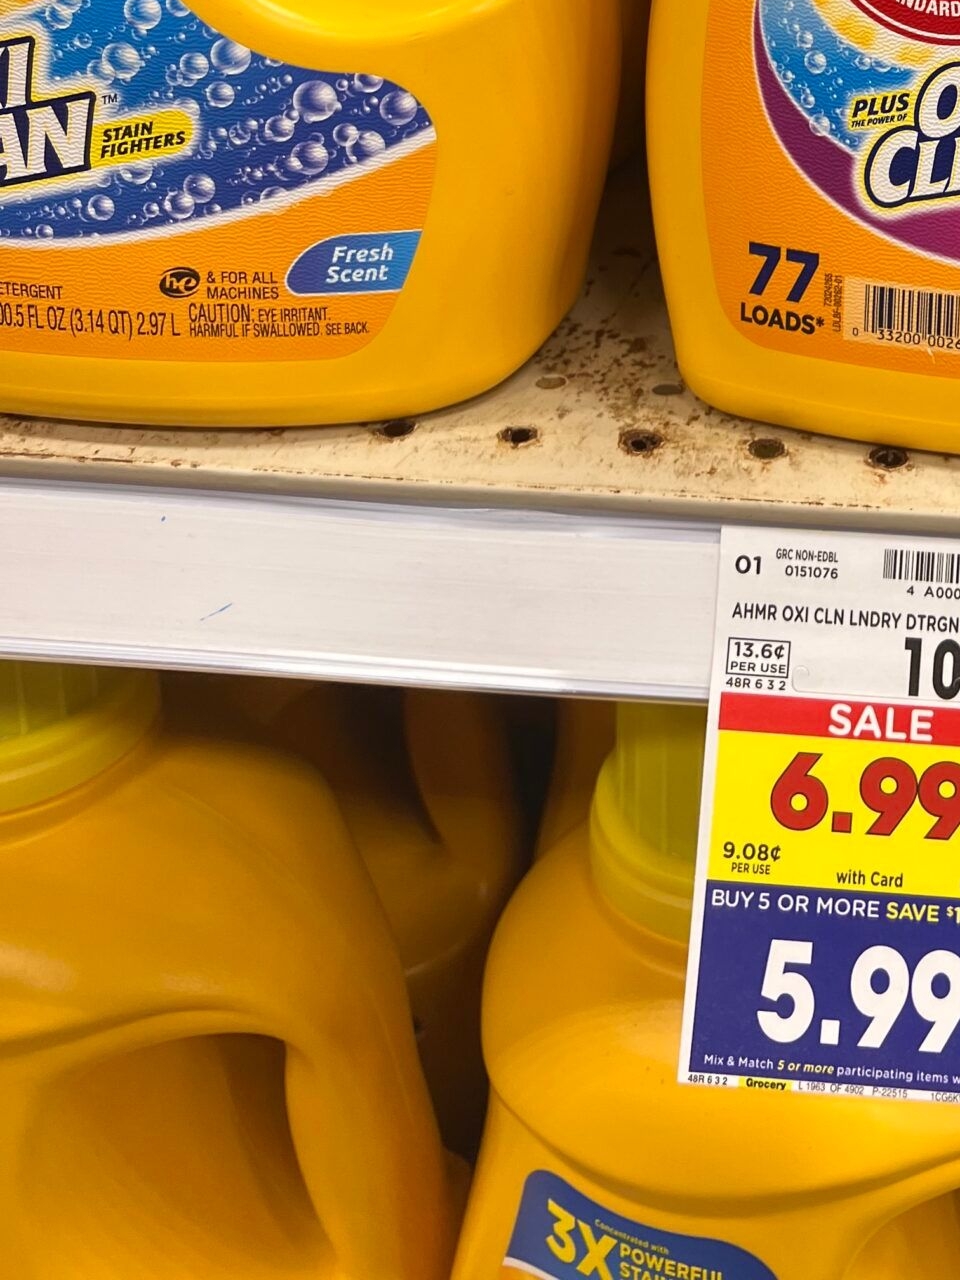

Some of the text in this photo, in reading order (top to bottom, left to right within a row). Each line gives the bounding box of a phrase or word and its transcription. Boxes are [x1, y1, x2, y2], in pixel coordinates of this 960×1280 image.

[852, 92, 910, 118] PLUS
[852, 116, 895, 128] THE POWER
[102, 122, 153, 143] STAIN
[100, 132, 186, 159] FIGHTERS
[332, 242, 394, 263] Fresh
[206, 271, 278, 284] & FOR ALL
[326, 264, 389, 284] Scent
[748, 242, 820, 304] 77
[207, 287, 279, 300] MACHINES
[28, 304, 181, 341] FL OZ (3.14 QT) 2.97 L
[188, 303, 331, 324] CAUTION: EYE IRRITANT.
[190, 322, 370, 338] HARMFUL IF SWALLOWED. SEE BACK.
[877, 330, 921, 345] 33200
[776, 548, 794, 561] GRC
[795, 550, 839, 563] NON-EDBL
[784, 565, 839, 579] 0151076
[906, 586, 915, 596] 4
[732, 602, 777, 621] AHMR
[782, 606, 809, 623] OXI
[814, 609, 844, 625] CLN
[850, 611, 901, 630] LNDRY
[734, 642, 785, 660] 13.6¢
[730, 660, 787, 675] PER USE
[726, 677, 751, 690] 48R
[828, 703, 934, 742] SALE
[723, 841, 781, 862] 9.08¢
[731, 862, 771, 875] PER USE
[836, 870, 903, 888] with Card
[711, 889, 755, 909] BUY
[758, 892, 770, 910] 5
[778, 894, 809, 912] OR
[816, 898, 880, 918] MORE
[886, 903, 940, 922] SAVE
[704, 1054, 724, 1065] Mix
[727, 1056, 735, 1066] &
[738, 1057, 773, 1070] Match
[788, 1062, 801, 1071] or
[803, 1064, 834, 1074] more
[836, 1065, 913, 1083] participating
[916, 1070, 949, 1084] items
[688, 1074, 705, 1084] 48R
[746, 1078, 787, 1091] Grocery
[546, 1198, 618, 1280] 3X
[595, 1219, 669, 1255] Concentrated with
